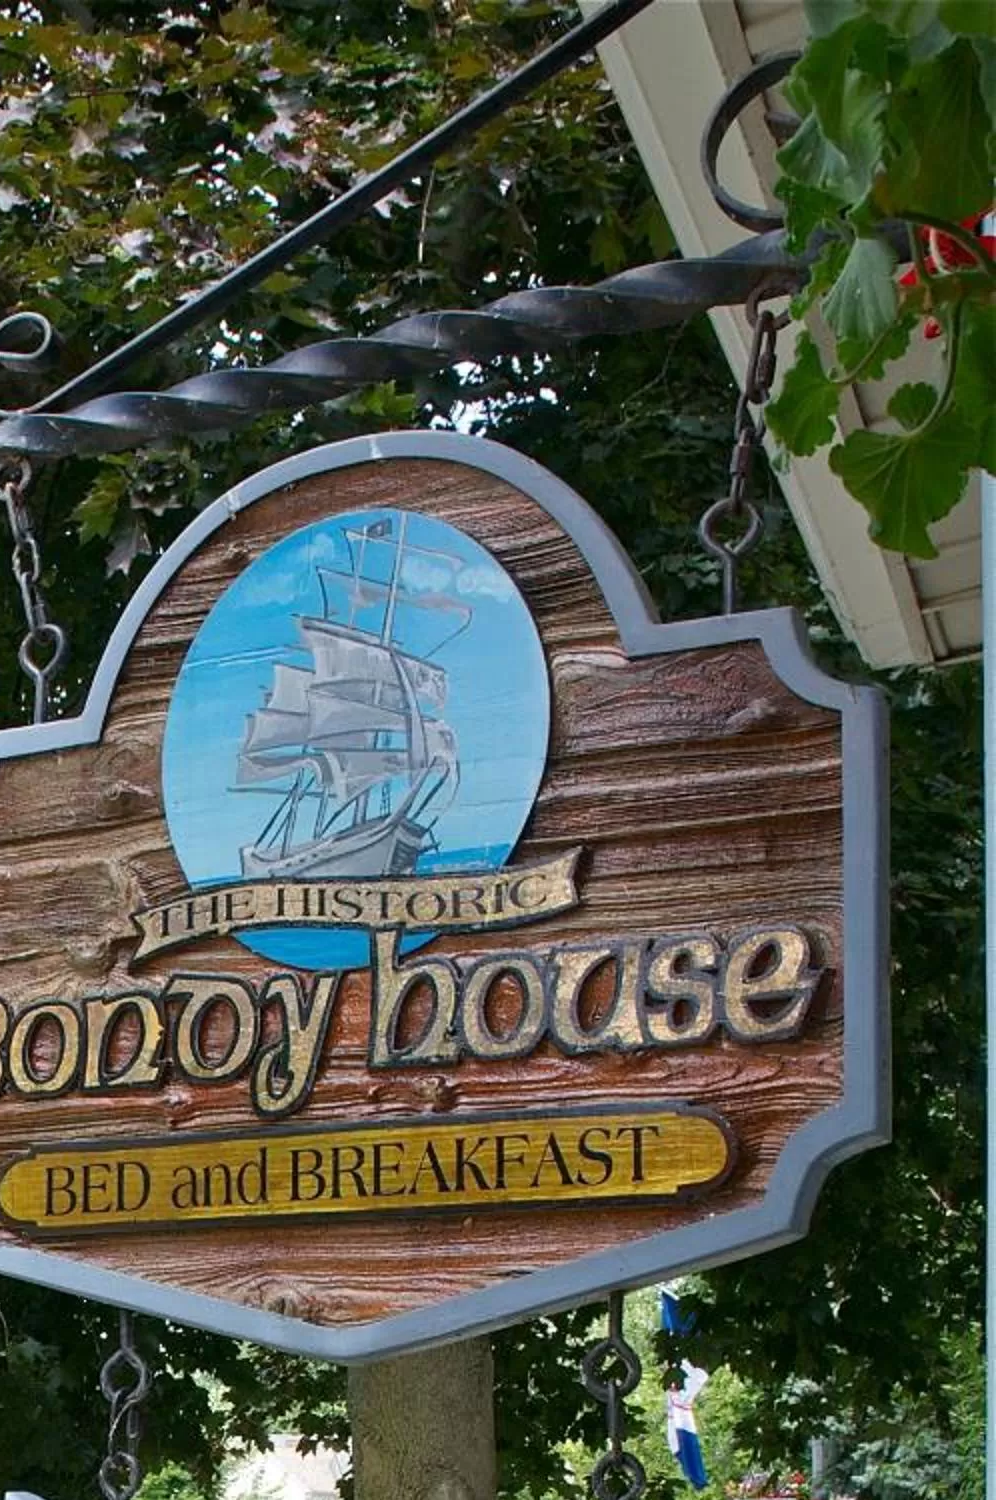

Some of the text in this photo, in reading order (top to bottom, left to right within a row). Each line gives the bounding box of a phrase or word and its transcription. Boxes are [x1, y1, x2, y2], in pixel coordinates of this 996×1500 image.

[156, 872, 549, 938] THE HISTORIC
[42, 1124, 660, 1217] BED and BREAKFAST
